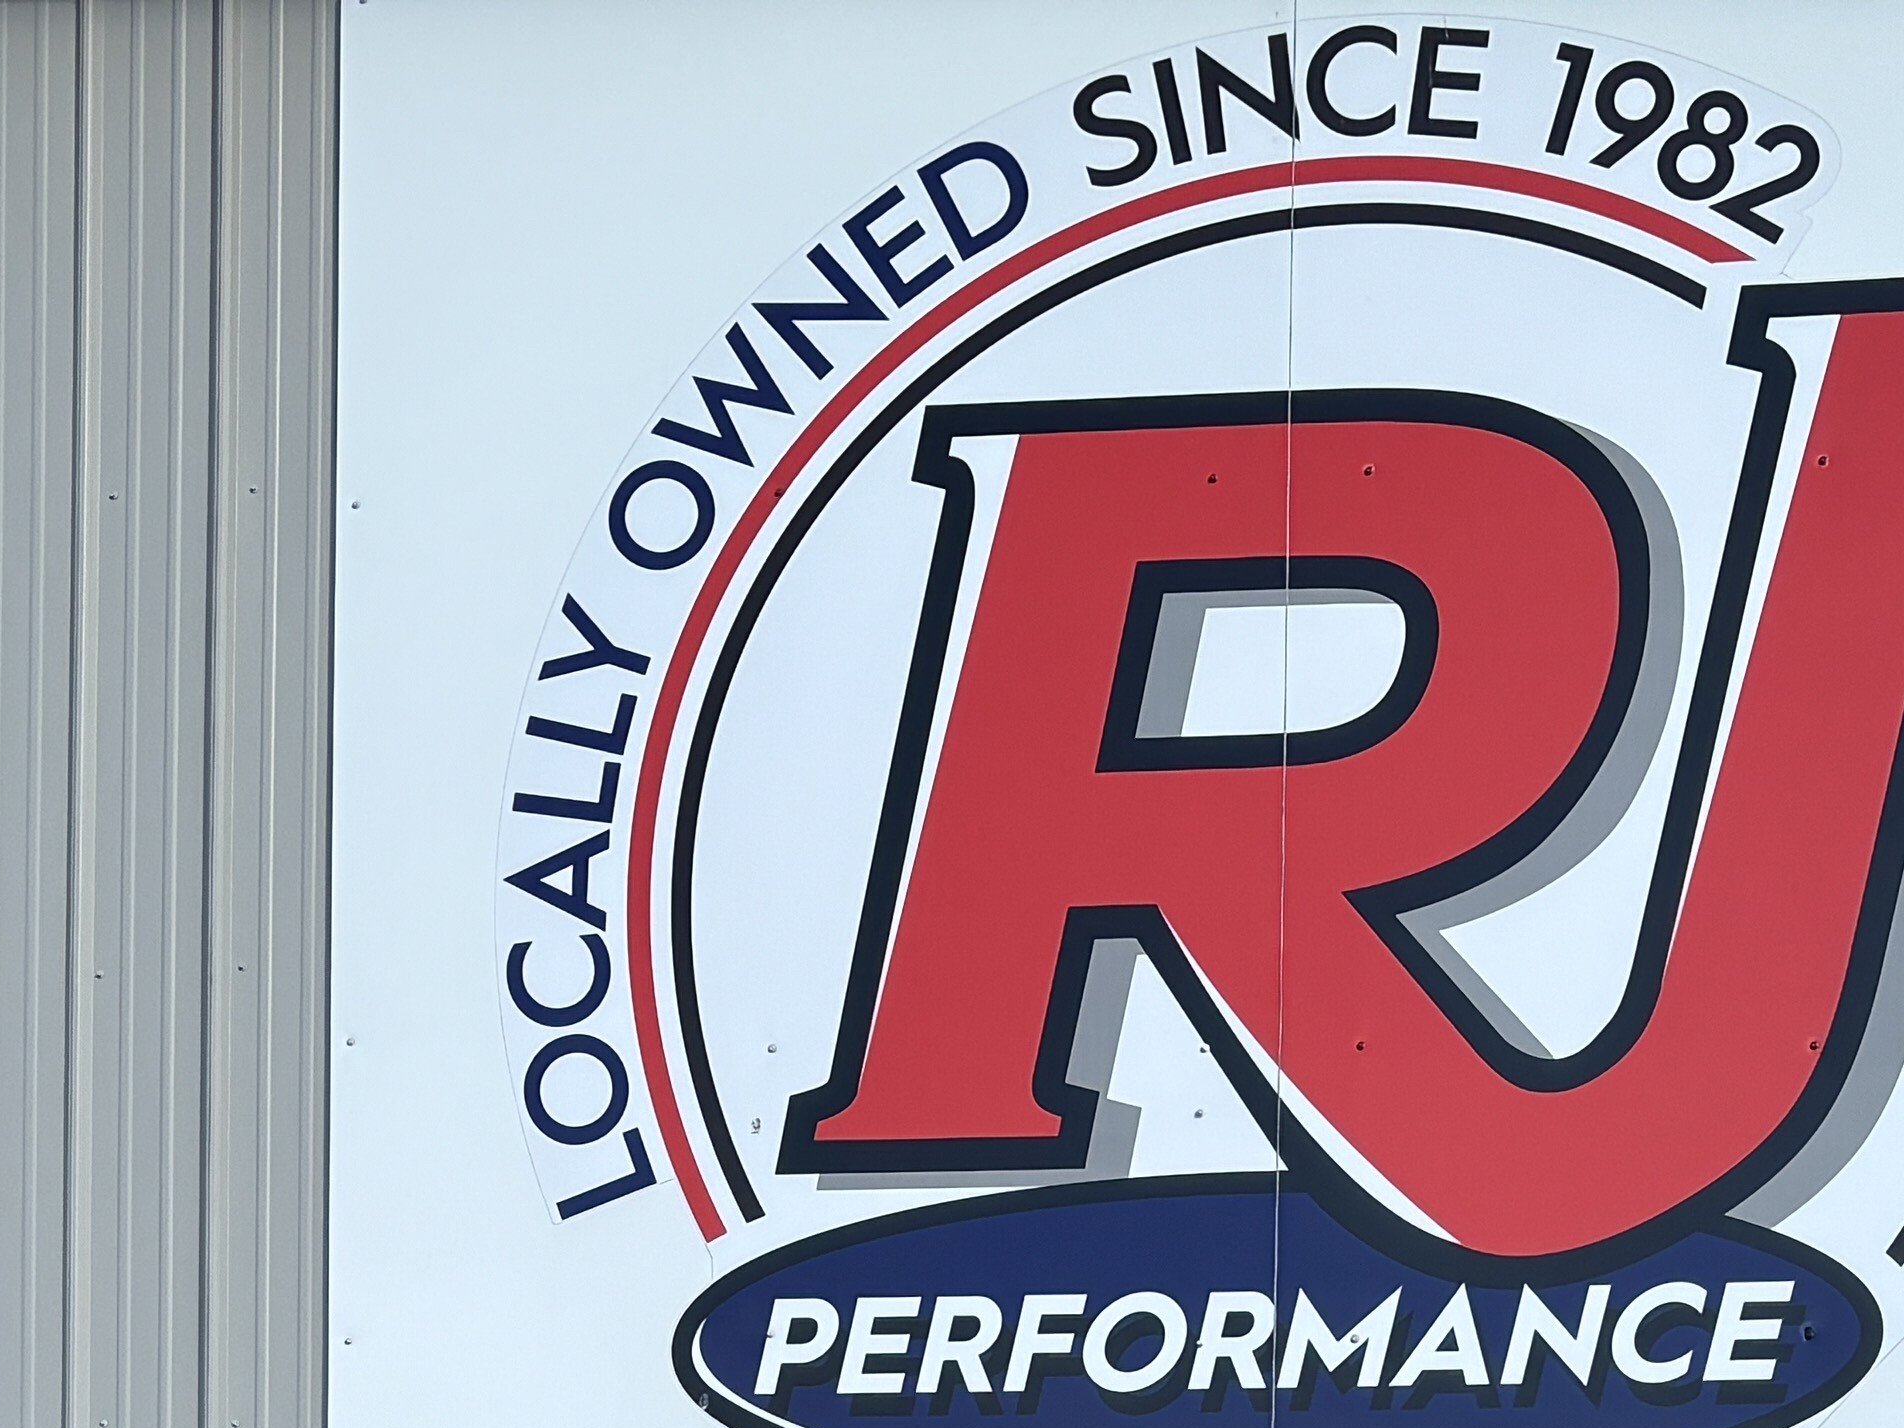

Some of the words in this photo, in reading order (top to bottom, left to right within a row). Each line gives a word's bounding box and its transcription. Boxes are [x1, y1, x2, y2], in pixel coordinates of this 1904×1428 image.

[502, 592, 658, 1221] LOCALLY
[608, 141, 1029, 571] OWNED
[1072, 24, 1490, 188] SINCE
[1545, 42, 1821, 245] 1982
[754, 1280, 1795, 1395] PERFORMANCE
